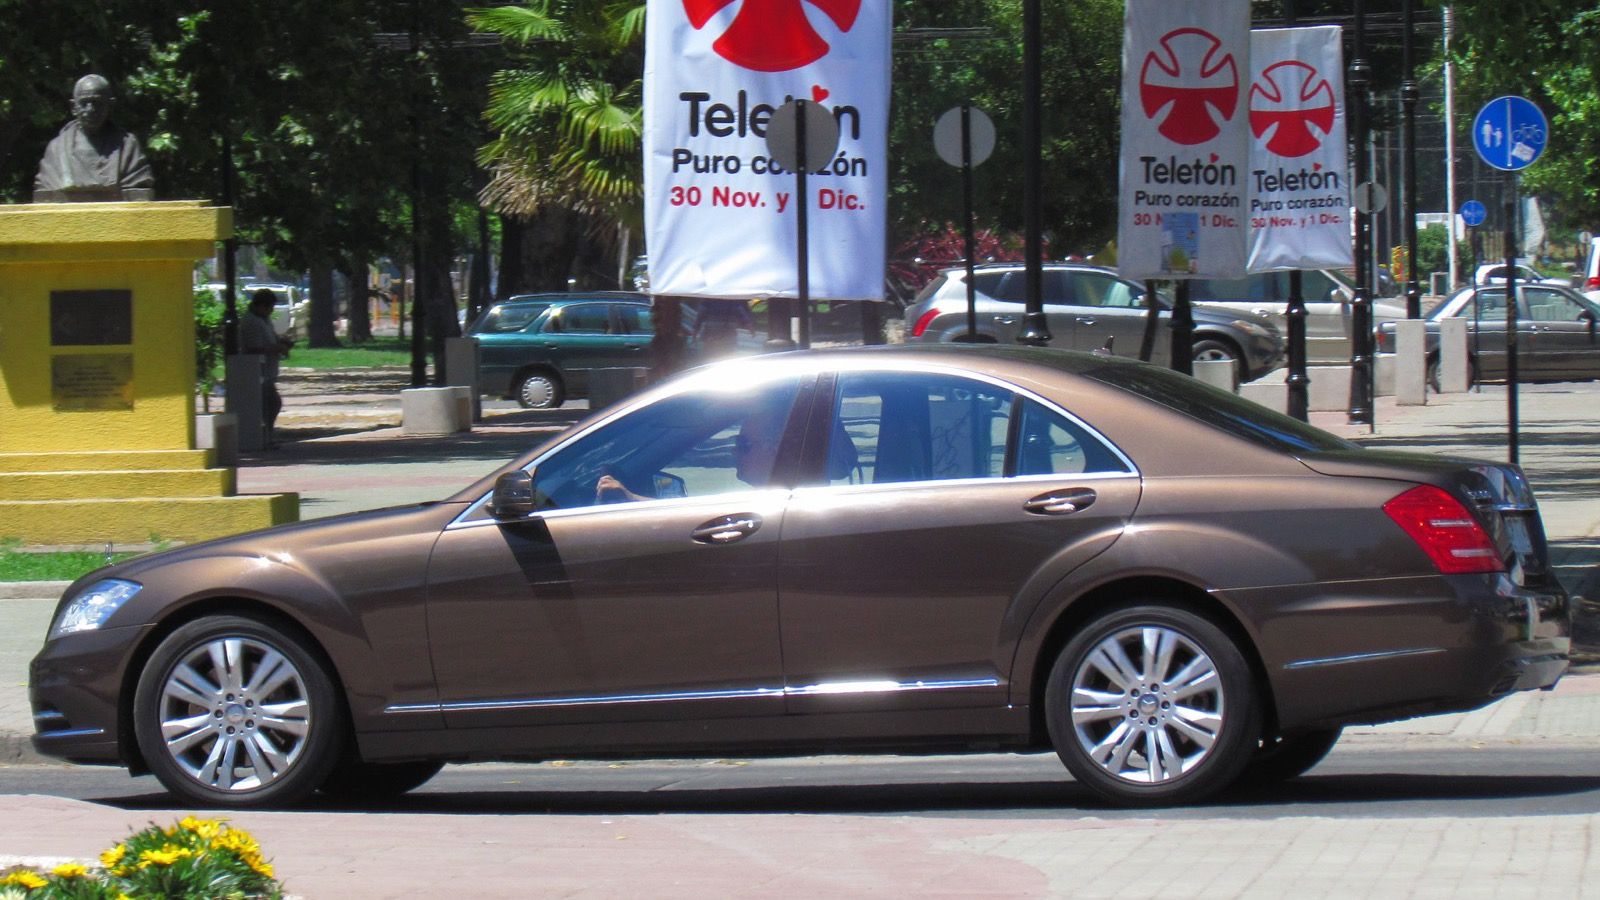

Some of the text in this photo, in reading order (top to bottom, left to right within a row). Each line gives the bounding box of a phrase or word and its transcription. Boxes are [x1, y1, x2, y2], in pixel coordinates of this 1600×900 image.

[679, 86, 860, 140] Telen
[672, 148, 867, 176] Puro coón
[670, 186, 865, 213] 30 Nov. y Dic.
[1135, 190, 1240, 207] Puro corazón
[1251, 195, 1343, 212] Puro corazón
[1134, 213, 1152, 226] 30
[1200, 214, 1207, 227] 1
[1212, 214, 1239, 227] Dic.
[1251, 213, 1344, 228] 30 Nov. y 1 Dic.
